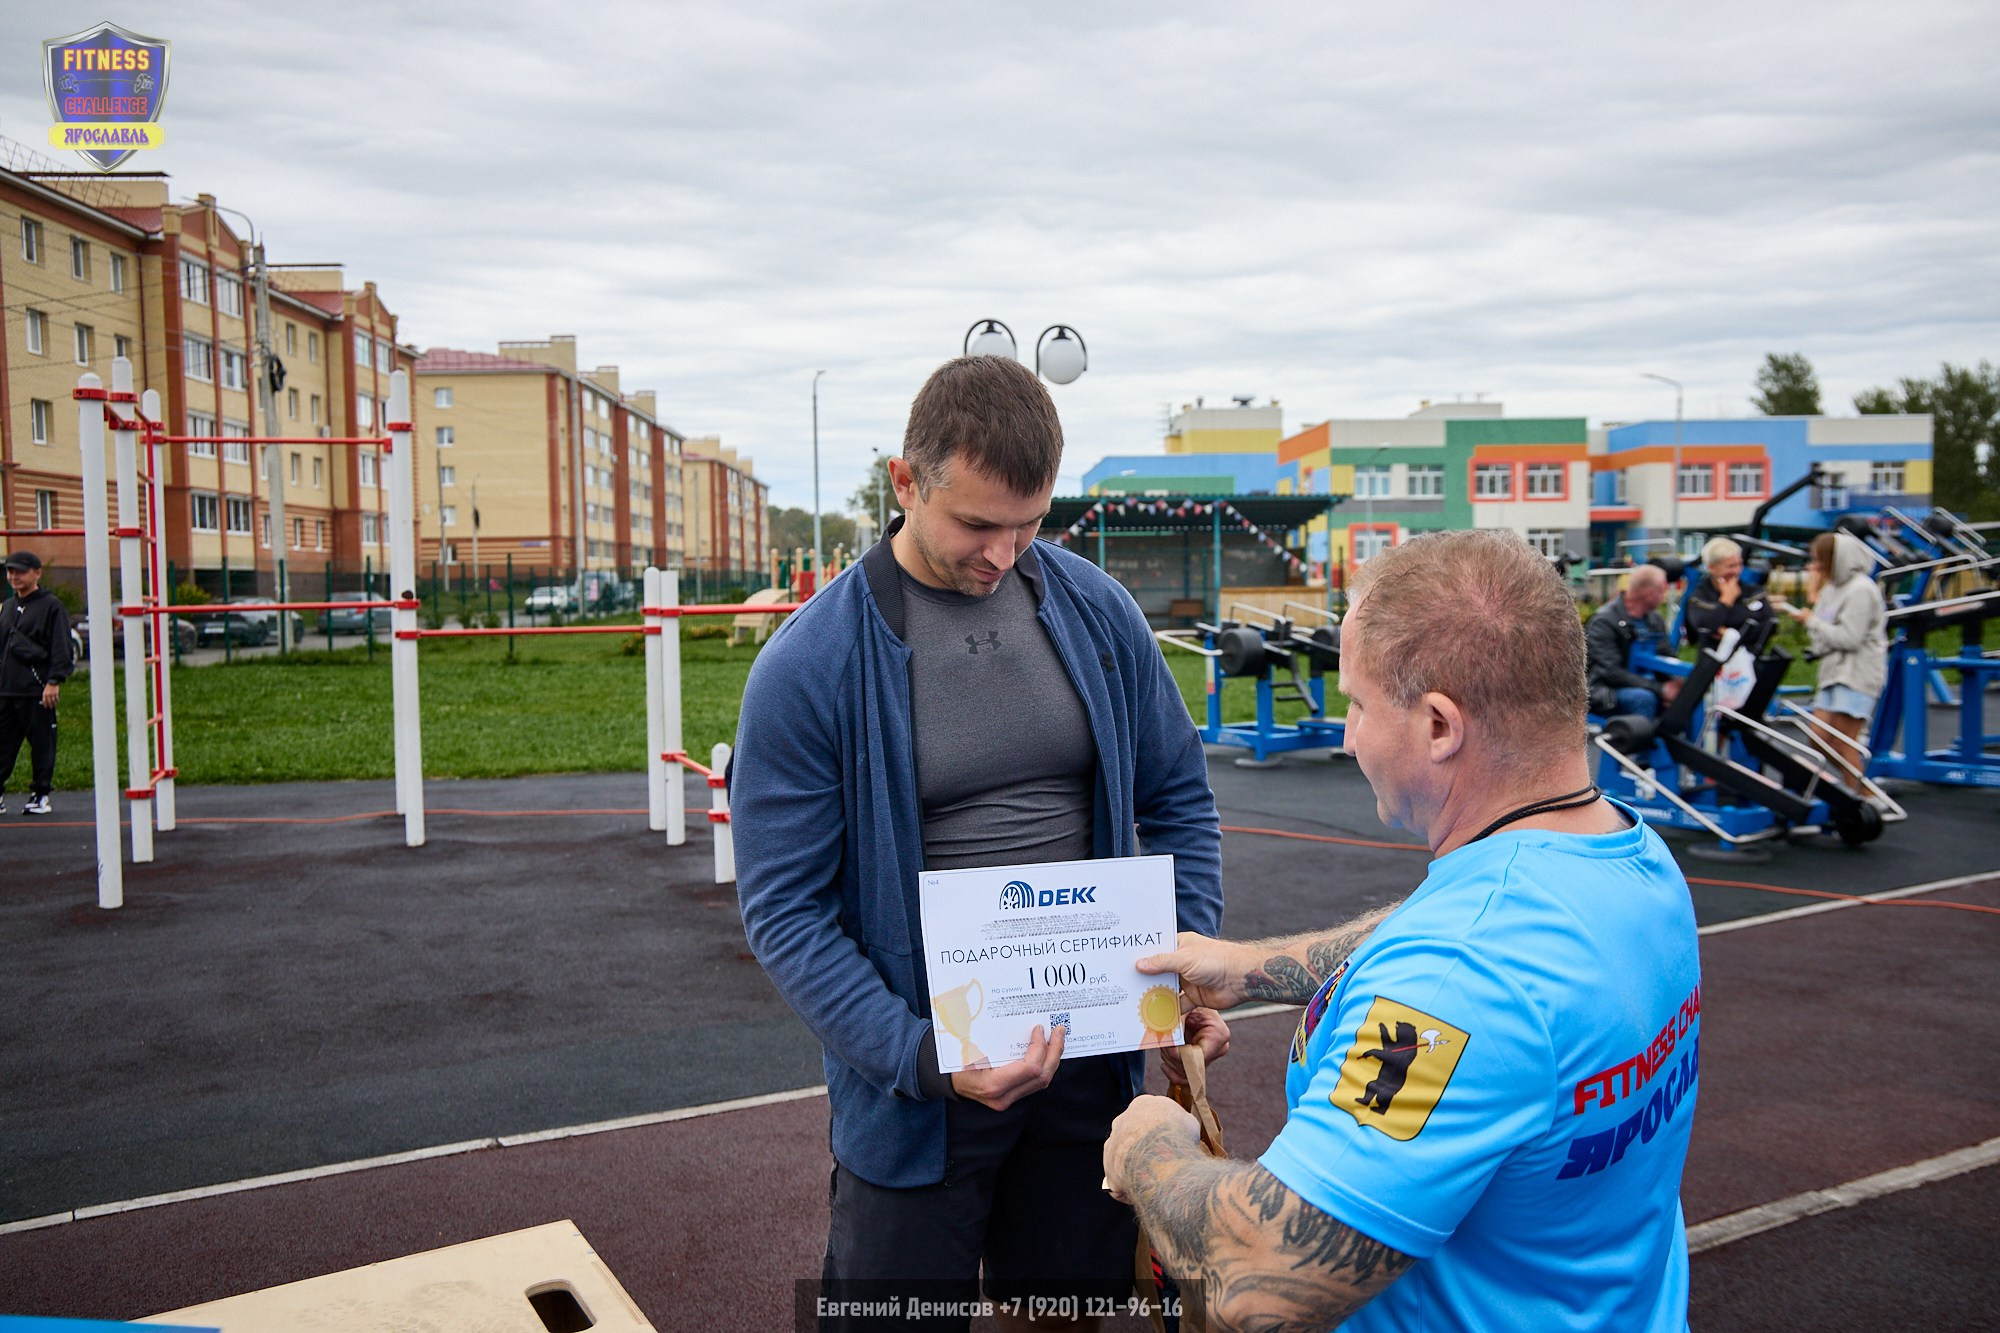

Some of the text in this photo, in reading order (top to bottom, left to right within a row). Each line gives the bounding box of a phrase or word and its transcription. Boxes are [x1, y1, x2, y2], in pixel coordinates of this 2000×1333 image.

[941, 932, 1163, 965] ПОДАРОЧНЫЙ СЕРТИФИКАТ
[1027, 966, 1036, 990] 1
[1044, 962, 1086, 988] 000
[1089, 974, 1110, 986] руб.
[1573, 1015, 1676, 1116] FITNESS
